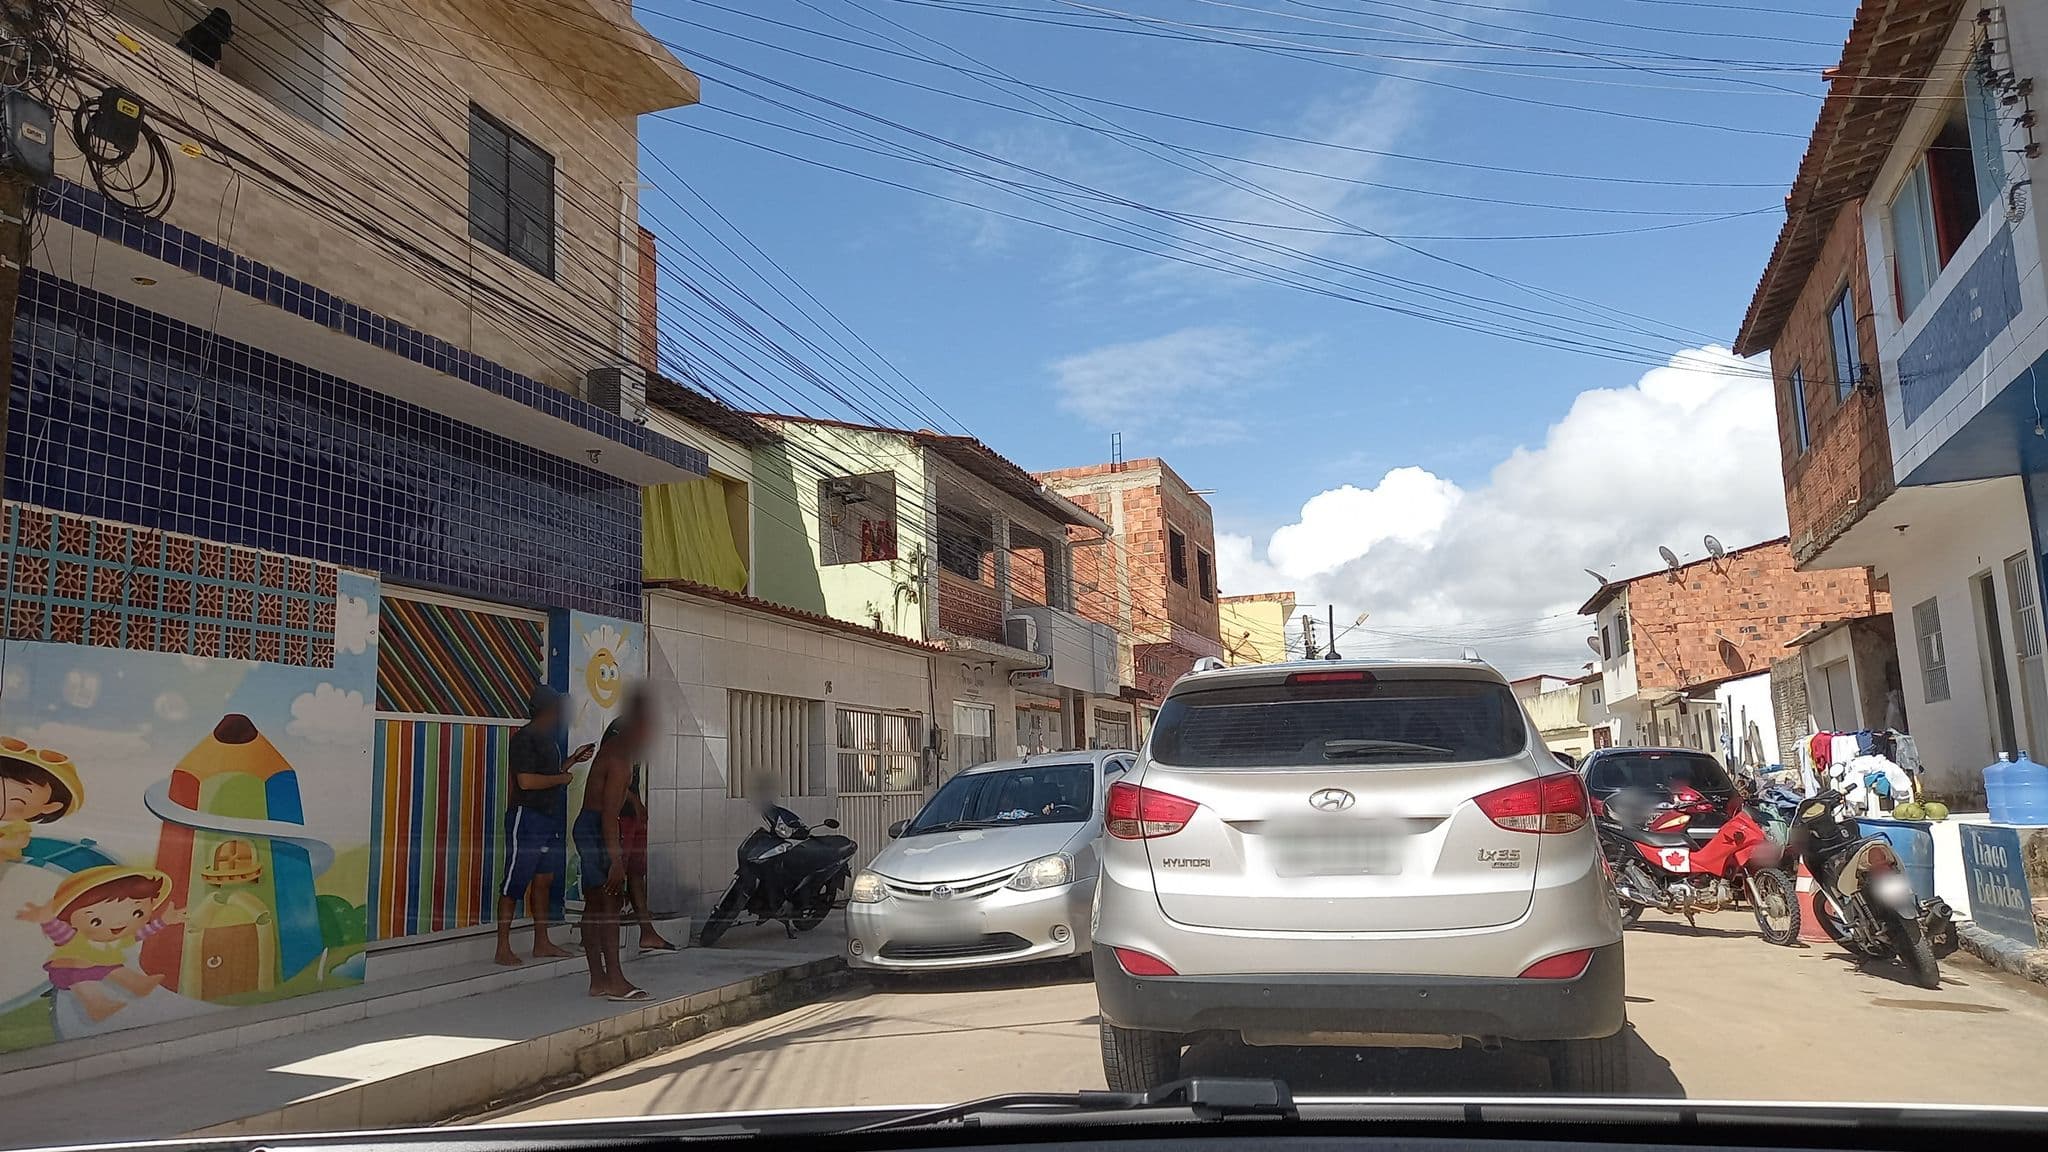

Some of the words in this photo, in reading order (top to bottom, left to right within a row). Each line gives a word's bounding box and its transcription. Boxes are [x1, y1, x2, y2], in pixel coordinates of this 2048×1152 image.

[1163, 858, 1211, 867] HYUNDAI
[1971, 829, 2007, 868] Tiago
[1974, 868, 2025, 909] Bebidas
